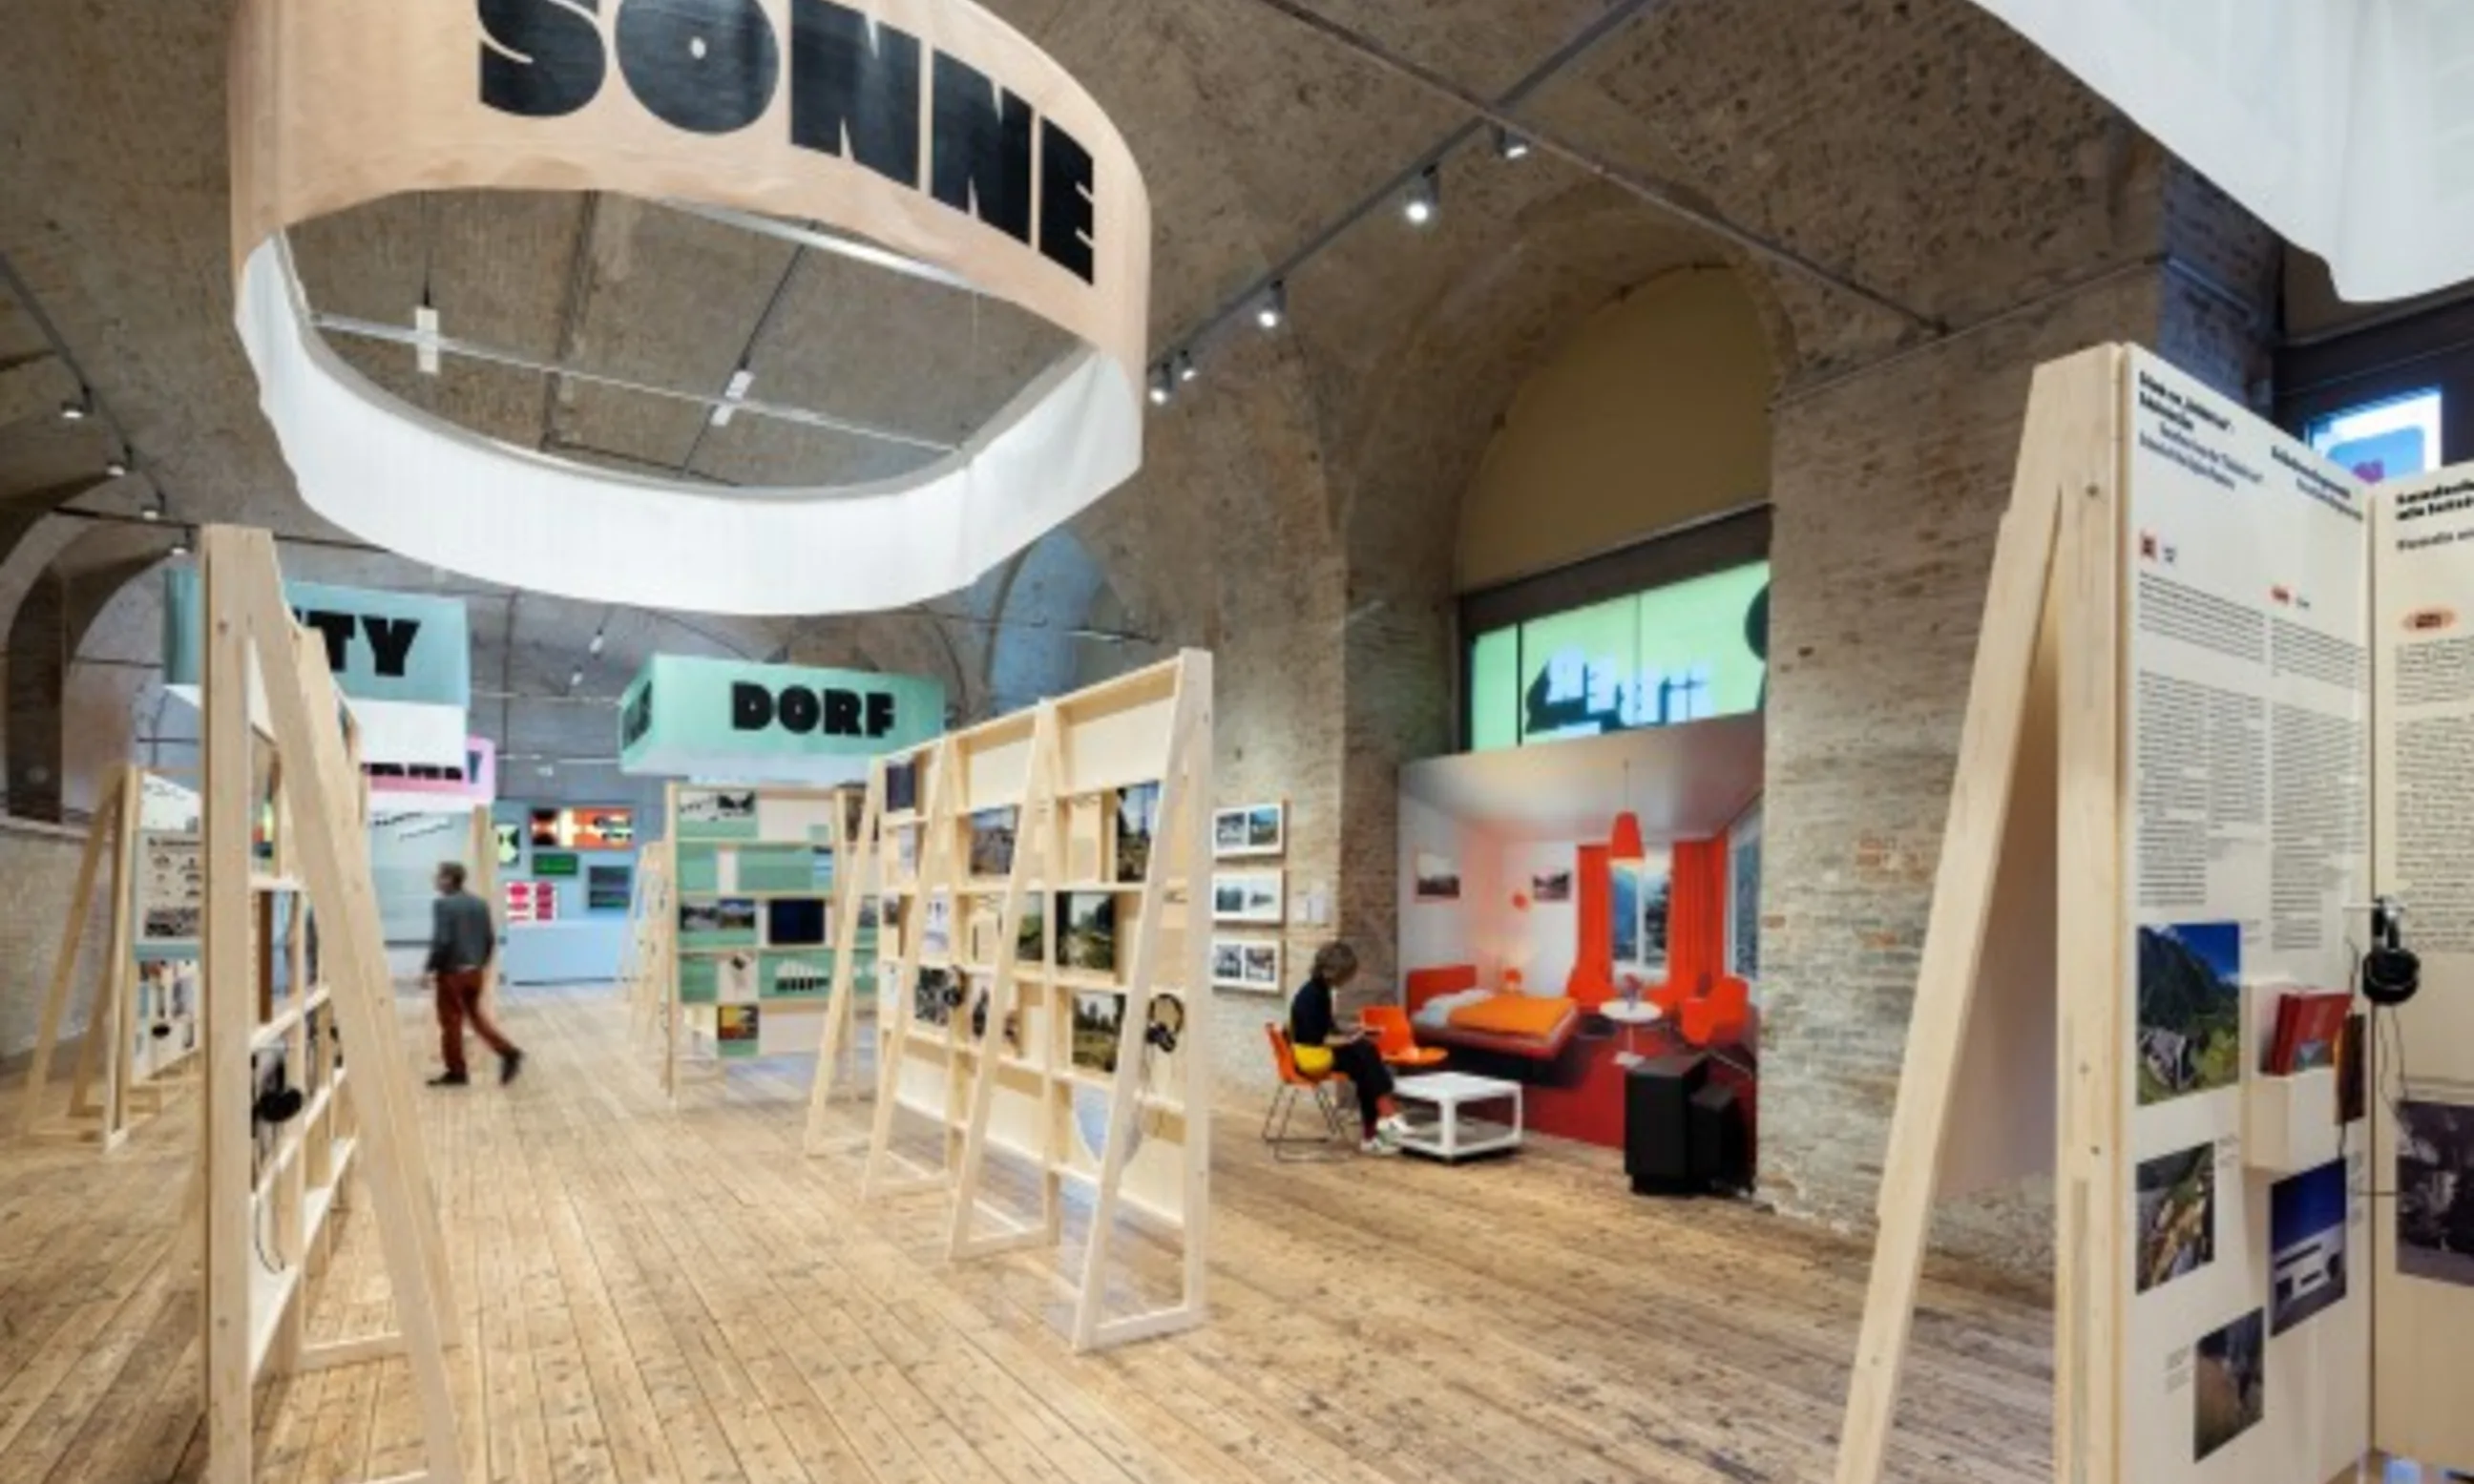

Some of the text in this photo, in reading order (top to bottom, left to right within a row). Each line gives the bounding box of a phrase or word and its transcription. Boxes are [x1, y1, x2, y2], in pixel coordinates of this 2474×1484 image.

[478, 0, 1094, 286] SONNE
[290, 606, 421, 677] TY
[731, 681, 896, 739] DORF
